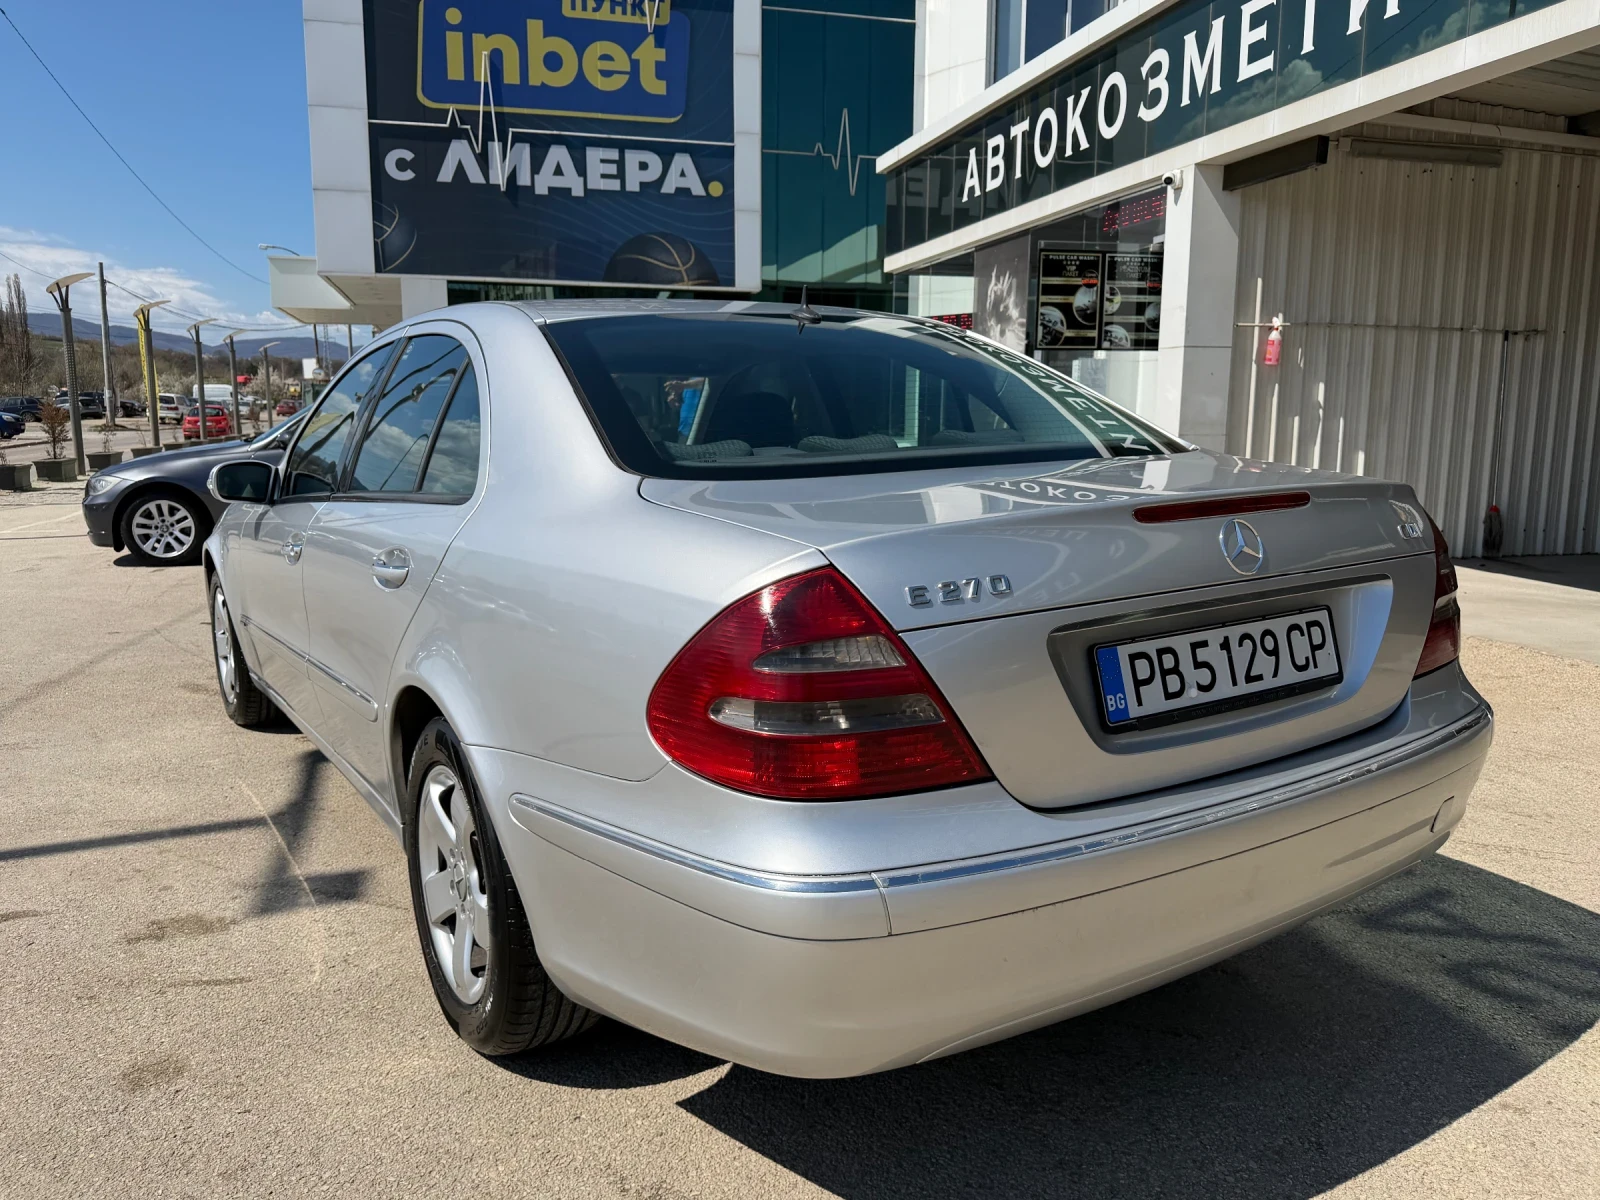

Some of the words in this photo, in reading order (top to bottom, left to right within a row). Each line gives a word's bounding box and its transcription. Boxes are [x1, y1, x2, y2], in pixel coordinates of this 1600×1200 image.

[445, 7, 667, 95] inbet
[904, 584, 931, 606] E
[937, 574, 1011, 602] 270
[1108, 694, 1126, 711] BG
